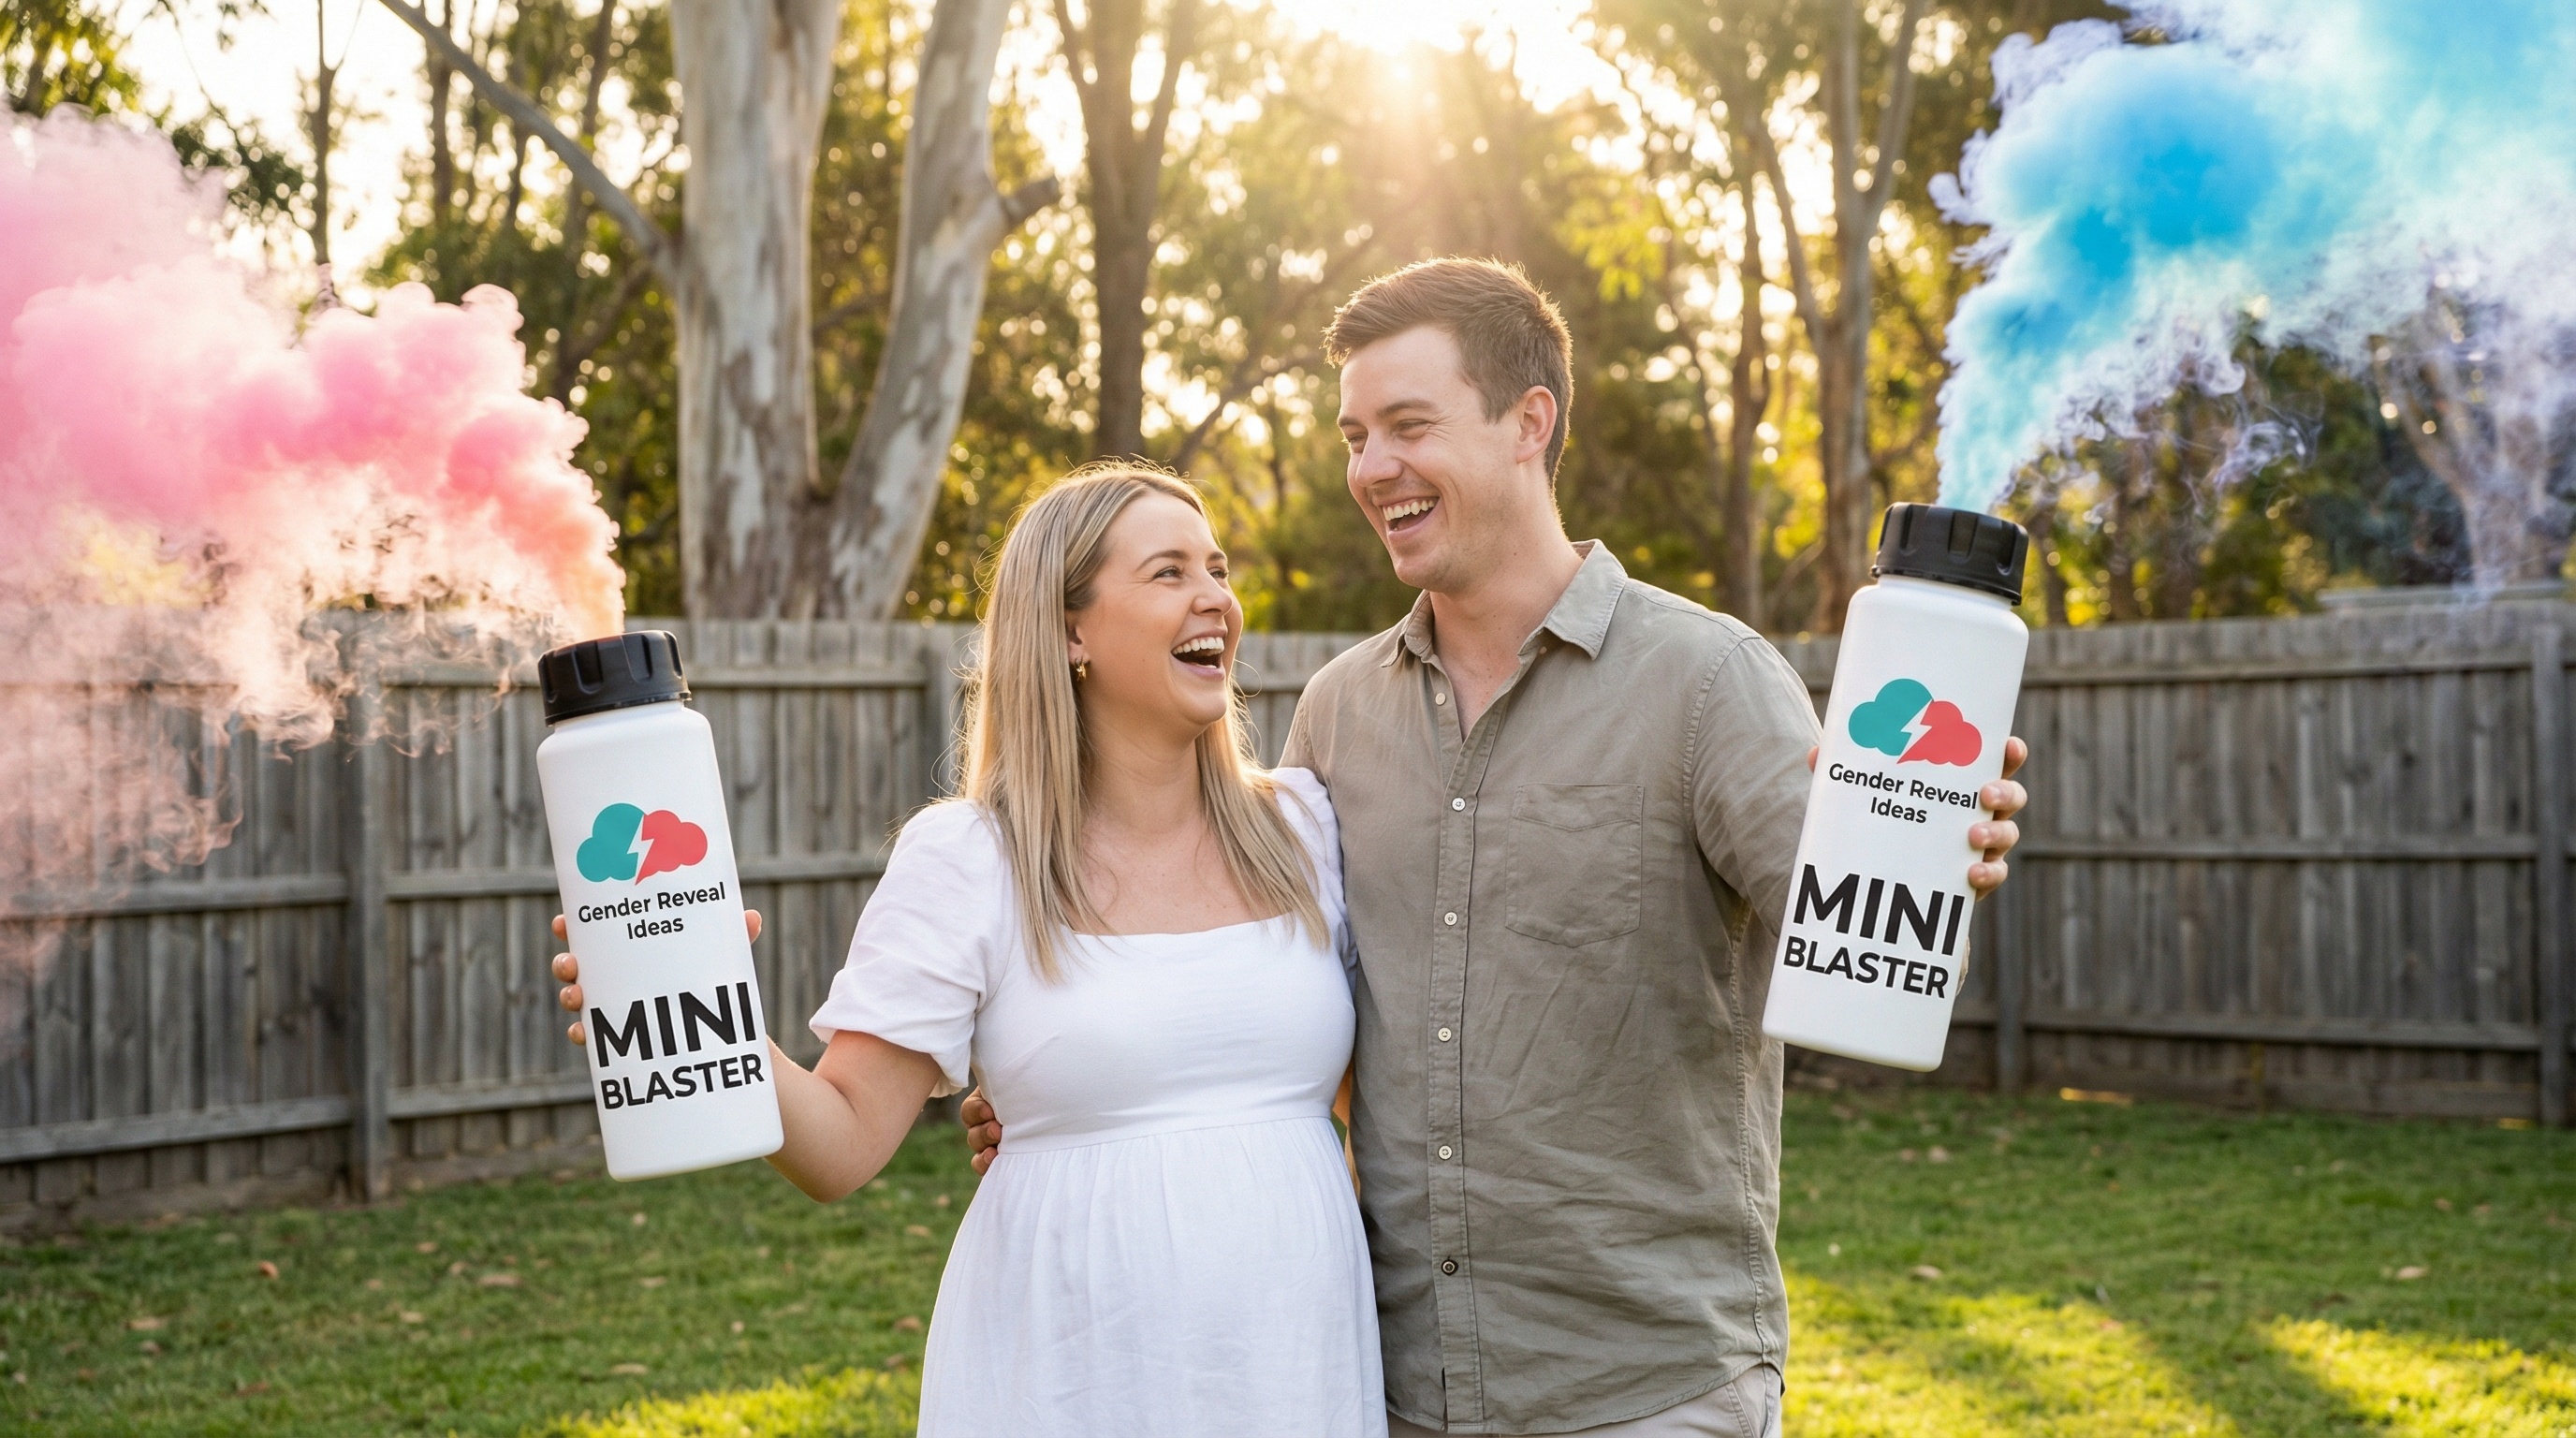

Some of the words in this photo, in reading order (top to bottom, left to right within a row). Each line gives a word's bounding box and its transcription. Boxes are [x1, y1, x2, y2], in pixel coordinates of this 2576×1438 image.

[1829, 763, 1905, 793] Gender
[1910, 779, 1979, 810] Reveal
[1870, 797, 1927, 824] Ideas
[578, 897, 651, 923] Gender
[657, 881, 725, 910] Reveal
[1793, 863, 1966, 957] MINI
[626, 917, 684, 940] Ideas
[1783, 935, 1949, 999] BLASTER
[590, 981, 756, 1068] MINI
[600, 1053, 765, 1110] BLASTER
